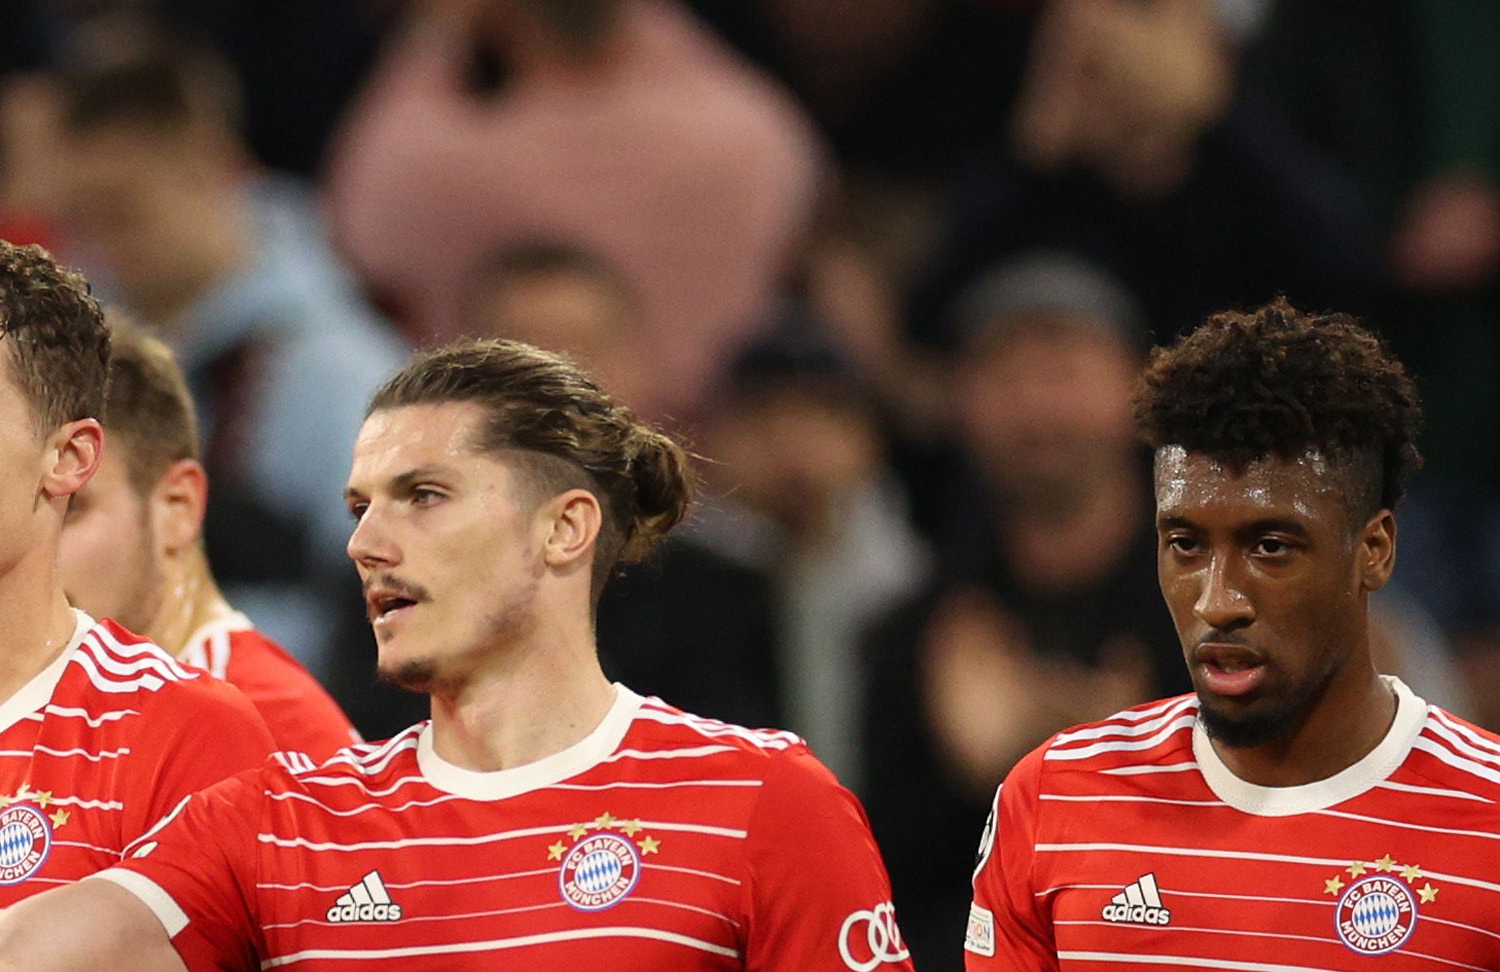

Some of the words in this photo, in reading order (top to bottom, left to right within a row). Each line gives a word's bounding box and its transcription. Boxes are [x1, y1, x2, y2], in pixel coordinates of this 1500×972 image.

[1, 810, 45, 839] BAYERN
[567, 851, 583, 870] FC
[583, 838, 633, 866] BAYERN
[1344, 890, 1361, 909] FC
[1362, 880, 1411, 913] BAYERN
[326, 902, 401, 922] adidas
[1102, 903, 1170, 925] adidas
